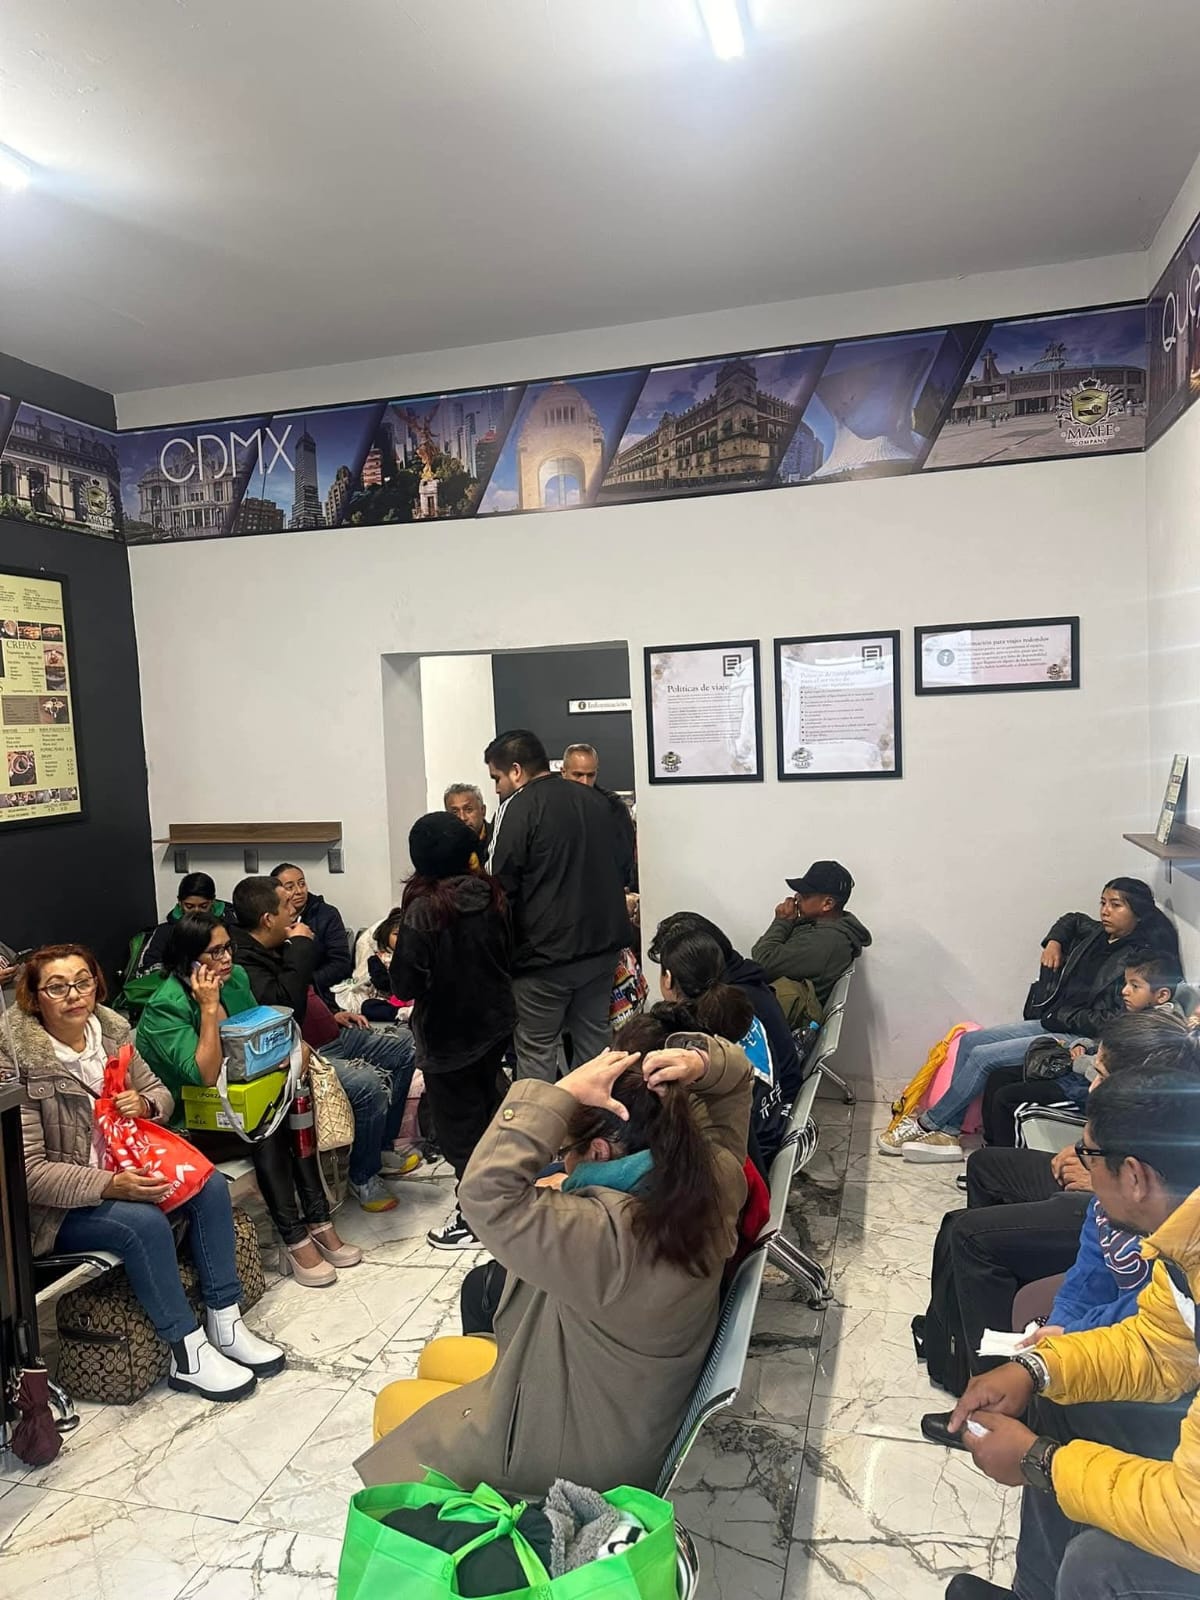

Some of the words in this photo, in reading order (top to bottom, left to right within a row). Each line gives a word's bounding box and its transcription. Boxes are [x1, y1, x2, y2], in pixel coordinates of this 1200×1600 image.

[1066, 423, 1115, 440] MAFE
[160, 424, 296, 483] CDMX
[6, 640, 38, 650] CREPAS
[700, 683, 710, 692] de
